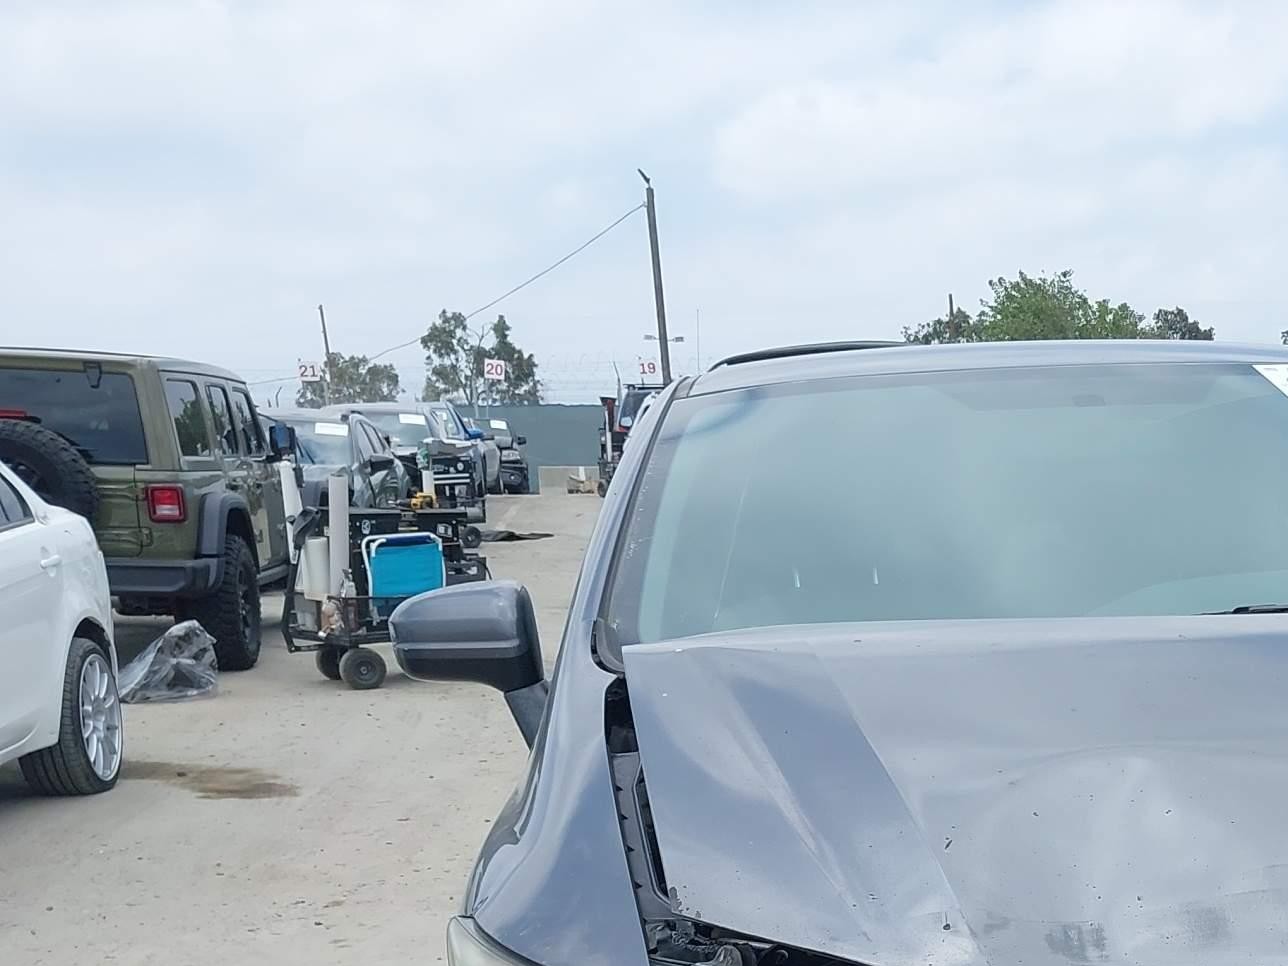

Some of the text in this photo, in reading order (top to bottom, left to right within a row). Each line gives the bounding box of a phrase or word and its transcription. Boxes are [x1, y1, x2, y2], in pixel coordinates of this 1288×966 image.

[299, 364, 318, 377] 21
[486, 362, 503, 377] 20
[640, 361, 656, 375] 19
